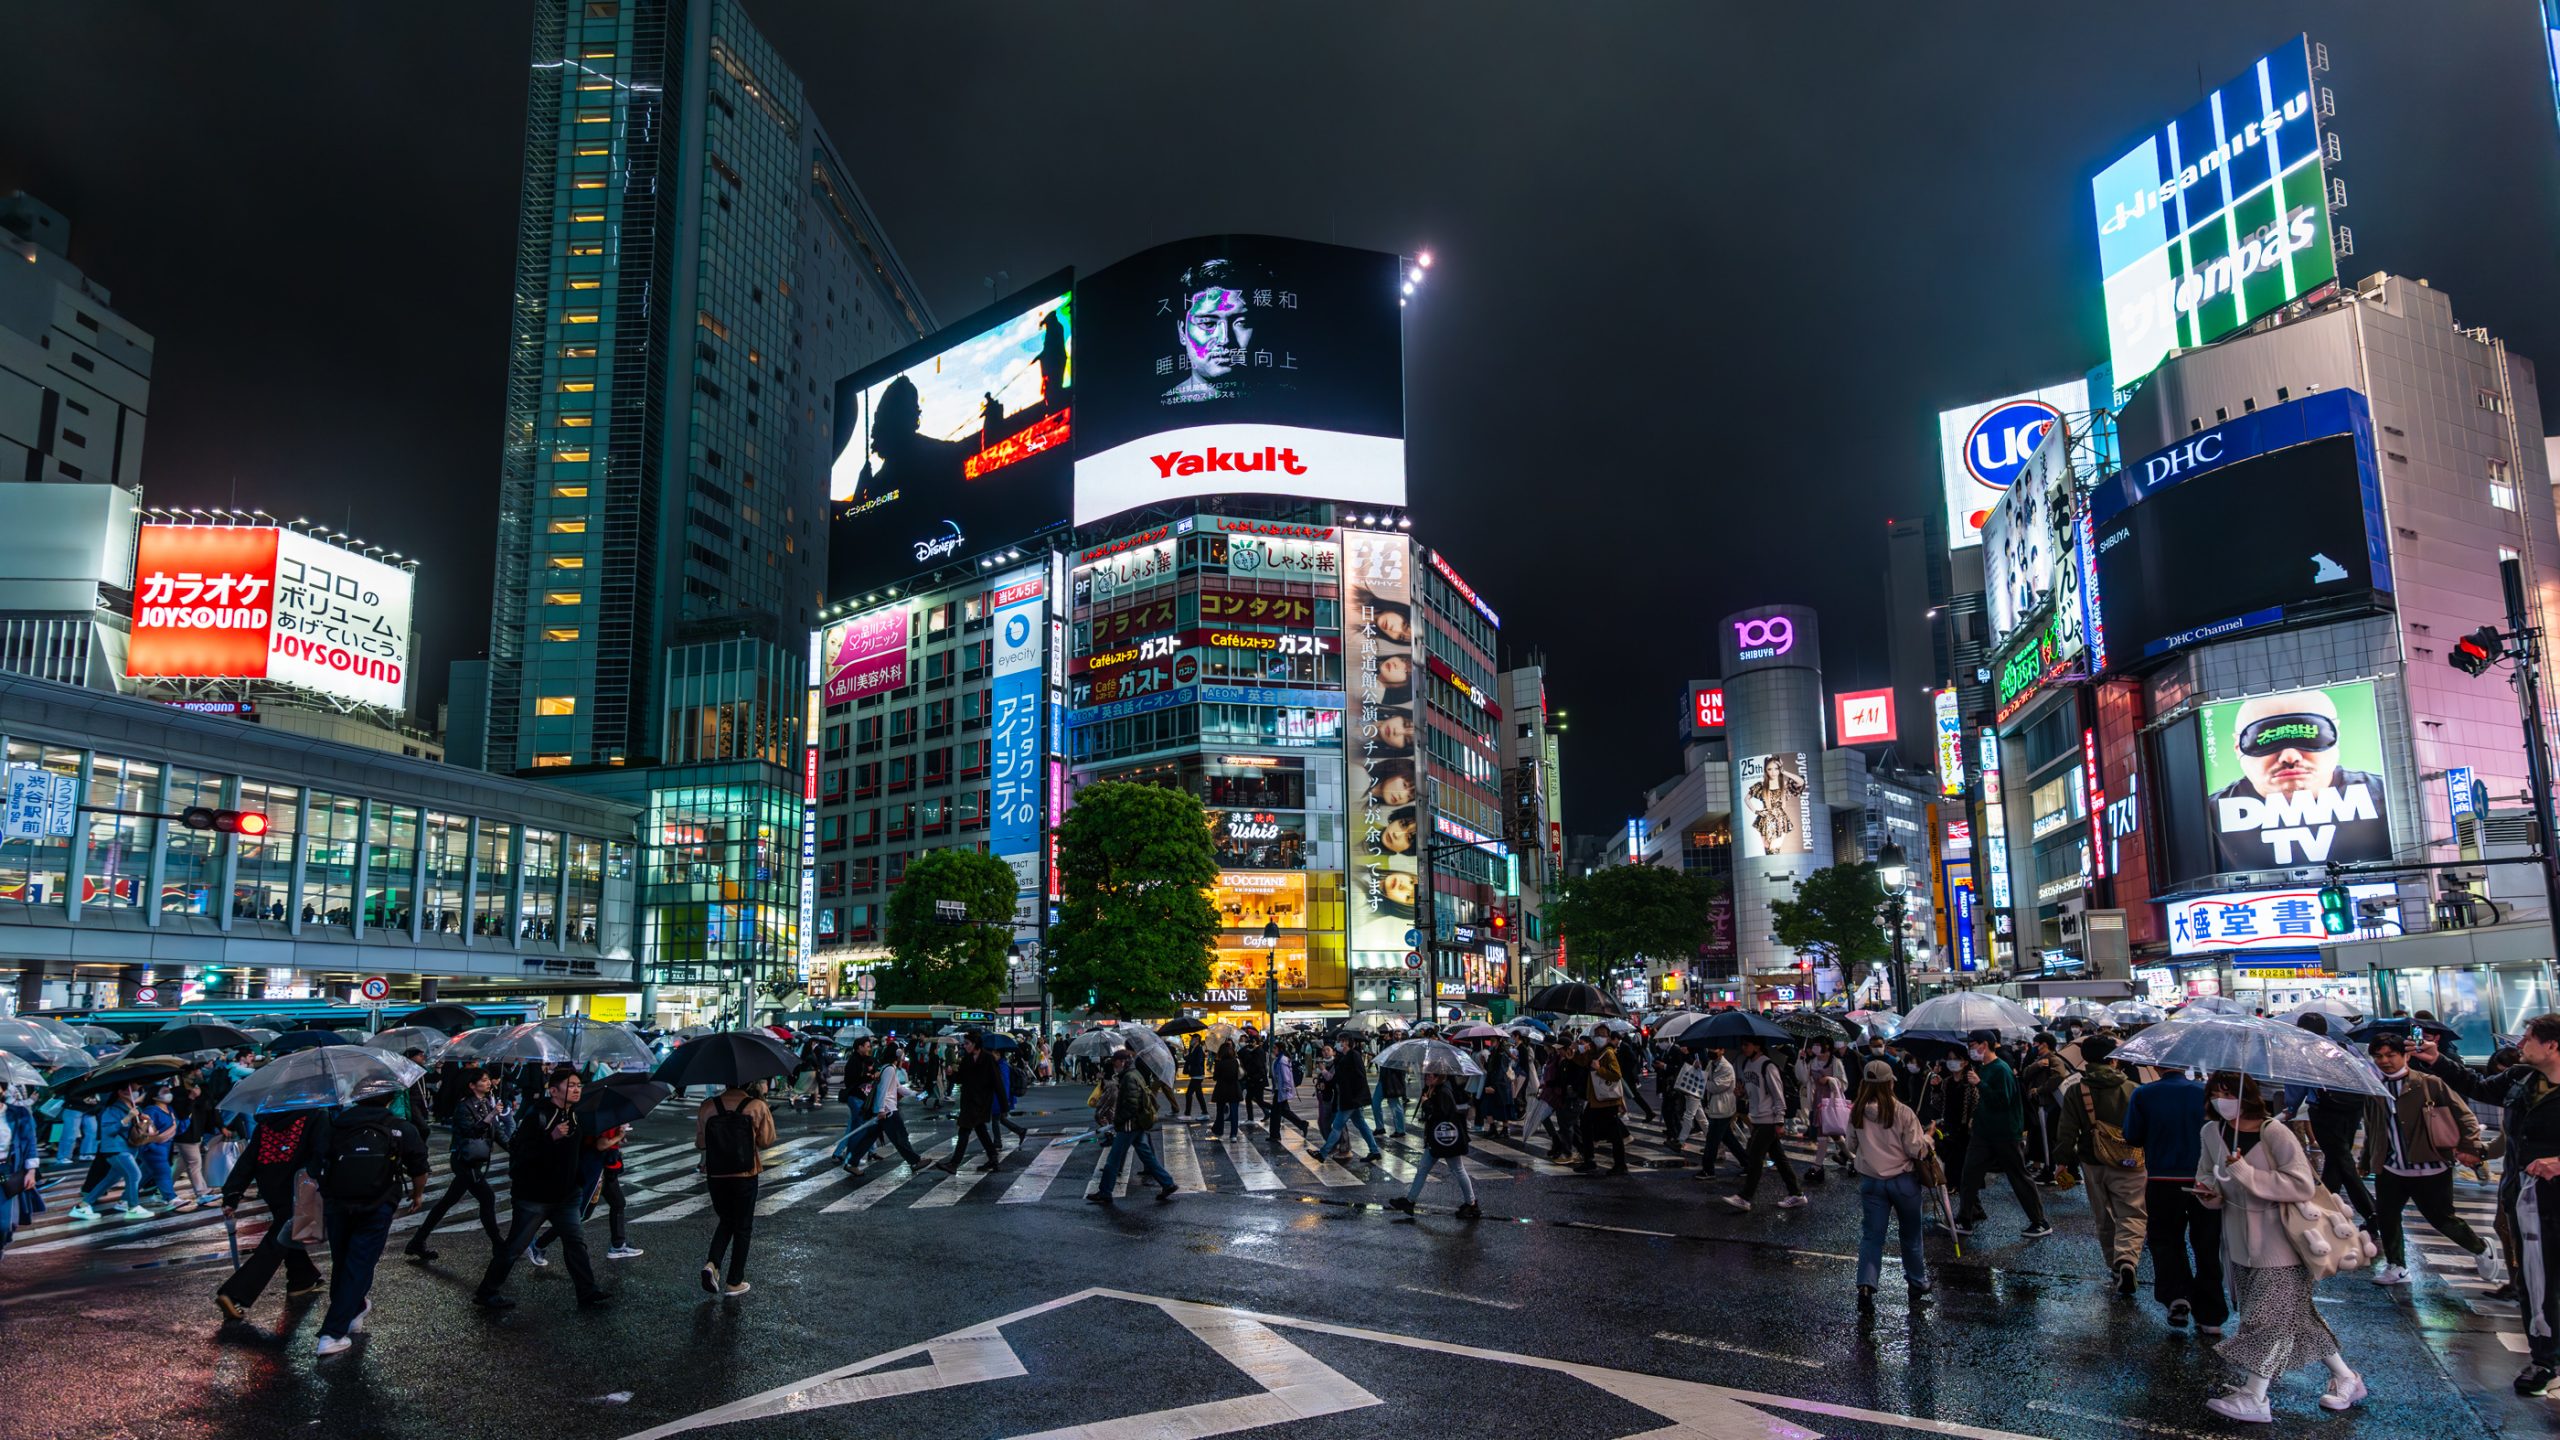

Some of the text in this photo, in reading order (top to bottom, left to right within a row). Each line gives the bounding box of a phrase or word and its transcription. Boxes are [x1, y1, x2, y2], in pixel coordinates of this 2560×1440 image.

[1150, 446, 1308, 478] Yakult
[2145, 432, 2225, 487] DHC
[914, 533, 965, 562] Disney+
[2100, 527, 2130, 554] SHIBUYA
[1121, 551, 1172, 583] しゃぶ葉
[1267, 546, 1336, 573] しゃぶ葉
[142, 571, 269, 606] カラオケ
[281, 556, 380, 608] ココロの
[998, 581, 1039, 605] 当ビル5F
[1075, 579, 1090, 595] 9F
[138, 606, 268, 629] JOYSOUND
[280, 586, 403, 642] ボリューム、
[1094, 603, 1174, 640] プライス
[1202, 595, 1311, 620] コンタクト
[278, 610, 403, 662] あげていこう。
[861, 615, 904, 638] 品川スキン
[861, 631, 899, 653] クリニック
[1734, 616, 1794, 655] 109
[2168, 618, 2243, 649] DHC Channel
[272, 633, 402, 685] JOYSOUND
[998, 648, 1037, 667] eyecity
[1140, 634, 1181, 661] ガスト
[1279, 634, 1329, 656] ガスト
[1739, 648, 1774, 661] SHIBUYA
[835, 663, 902, 696] 品川美容外科
[1073, 684, 1091, 703] 7F
[1119, 666, 1169, 698] ガスト
[1207, 687, 1239, 698] AEON
[1700, 694, 1723, 708] UN
[1701, 708, 1725, 724] QL
[1852, 706, 1879, 725] H&M
[996, 697, 1018, 826] アイシティ
[1018, 692, 1035, 824] コンタクトの
[1360, 604, 1385, 913] 日本武道館公演のチケットが余ってます
[1741, 758, 1763, 776] 25th
[22, 775, 46, 834] 渋谷駅前
[55, 779, 73, 834] スクランブル式
[2452, 772, 2470, 812] 大盛堂商
[1801, 792, 1814, 850] hamasaki
[2218, 783, 2379, 834] DMM
[1228, 822, 1280, 840] Ushi8
[2259, 824, 2336, 865] TV
[1223, 875, 1287, 886] L'OCCITANE
[2174, 899, 2317, 945] 大盛堂書
[1485, 944, 1505, 963] LUSH
